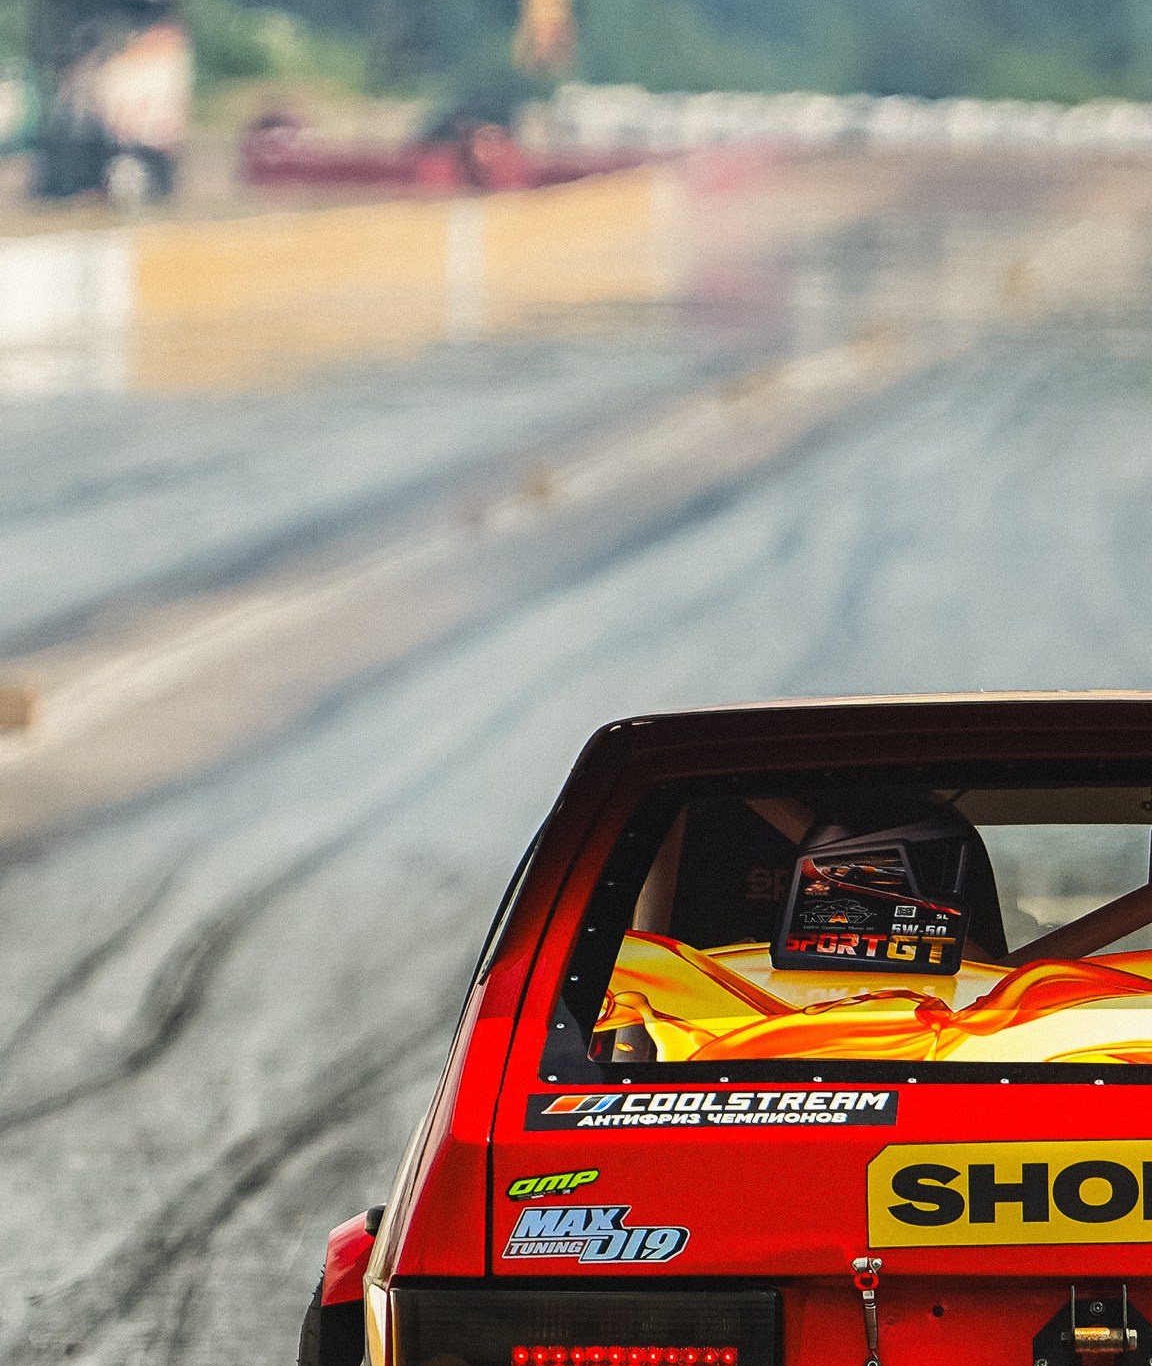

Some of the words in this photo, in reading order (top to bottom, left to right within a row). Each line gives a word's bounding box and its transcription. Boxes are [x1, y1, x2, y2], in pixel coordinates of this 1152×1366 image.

[620, 1091, 890, 1112] COOLSTREAM
[576, 1113, 701, 1127] АНТИФРИЗ
[707, 1112, 848, 1125] ЧЕМПИОНОВ
[513, 1208, 621, 1238] MAX
[509, 1241, 584, 1255] TUNING
